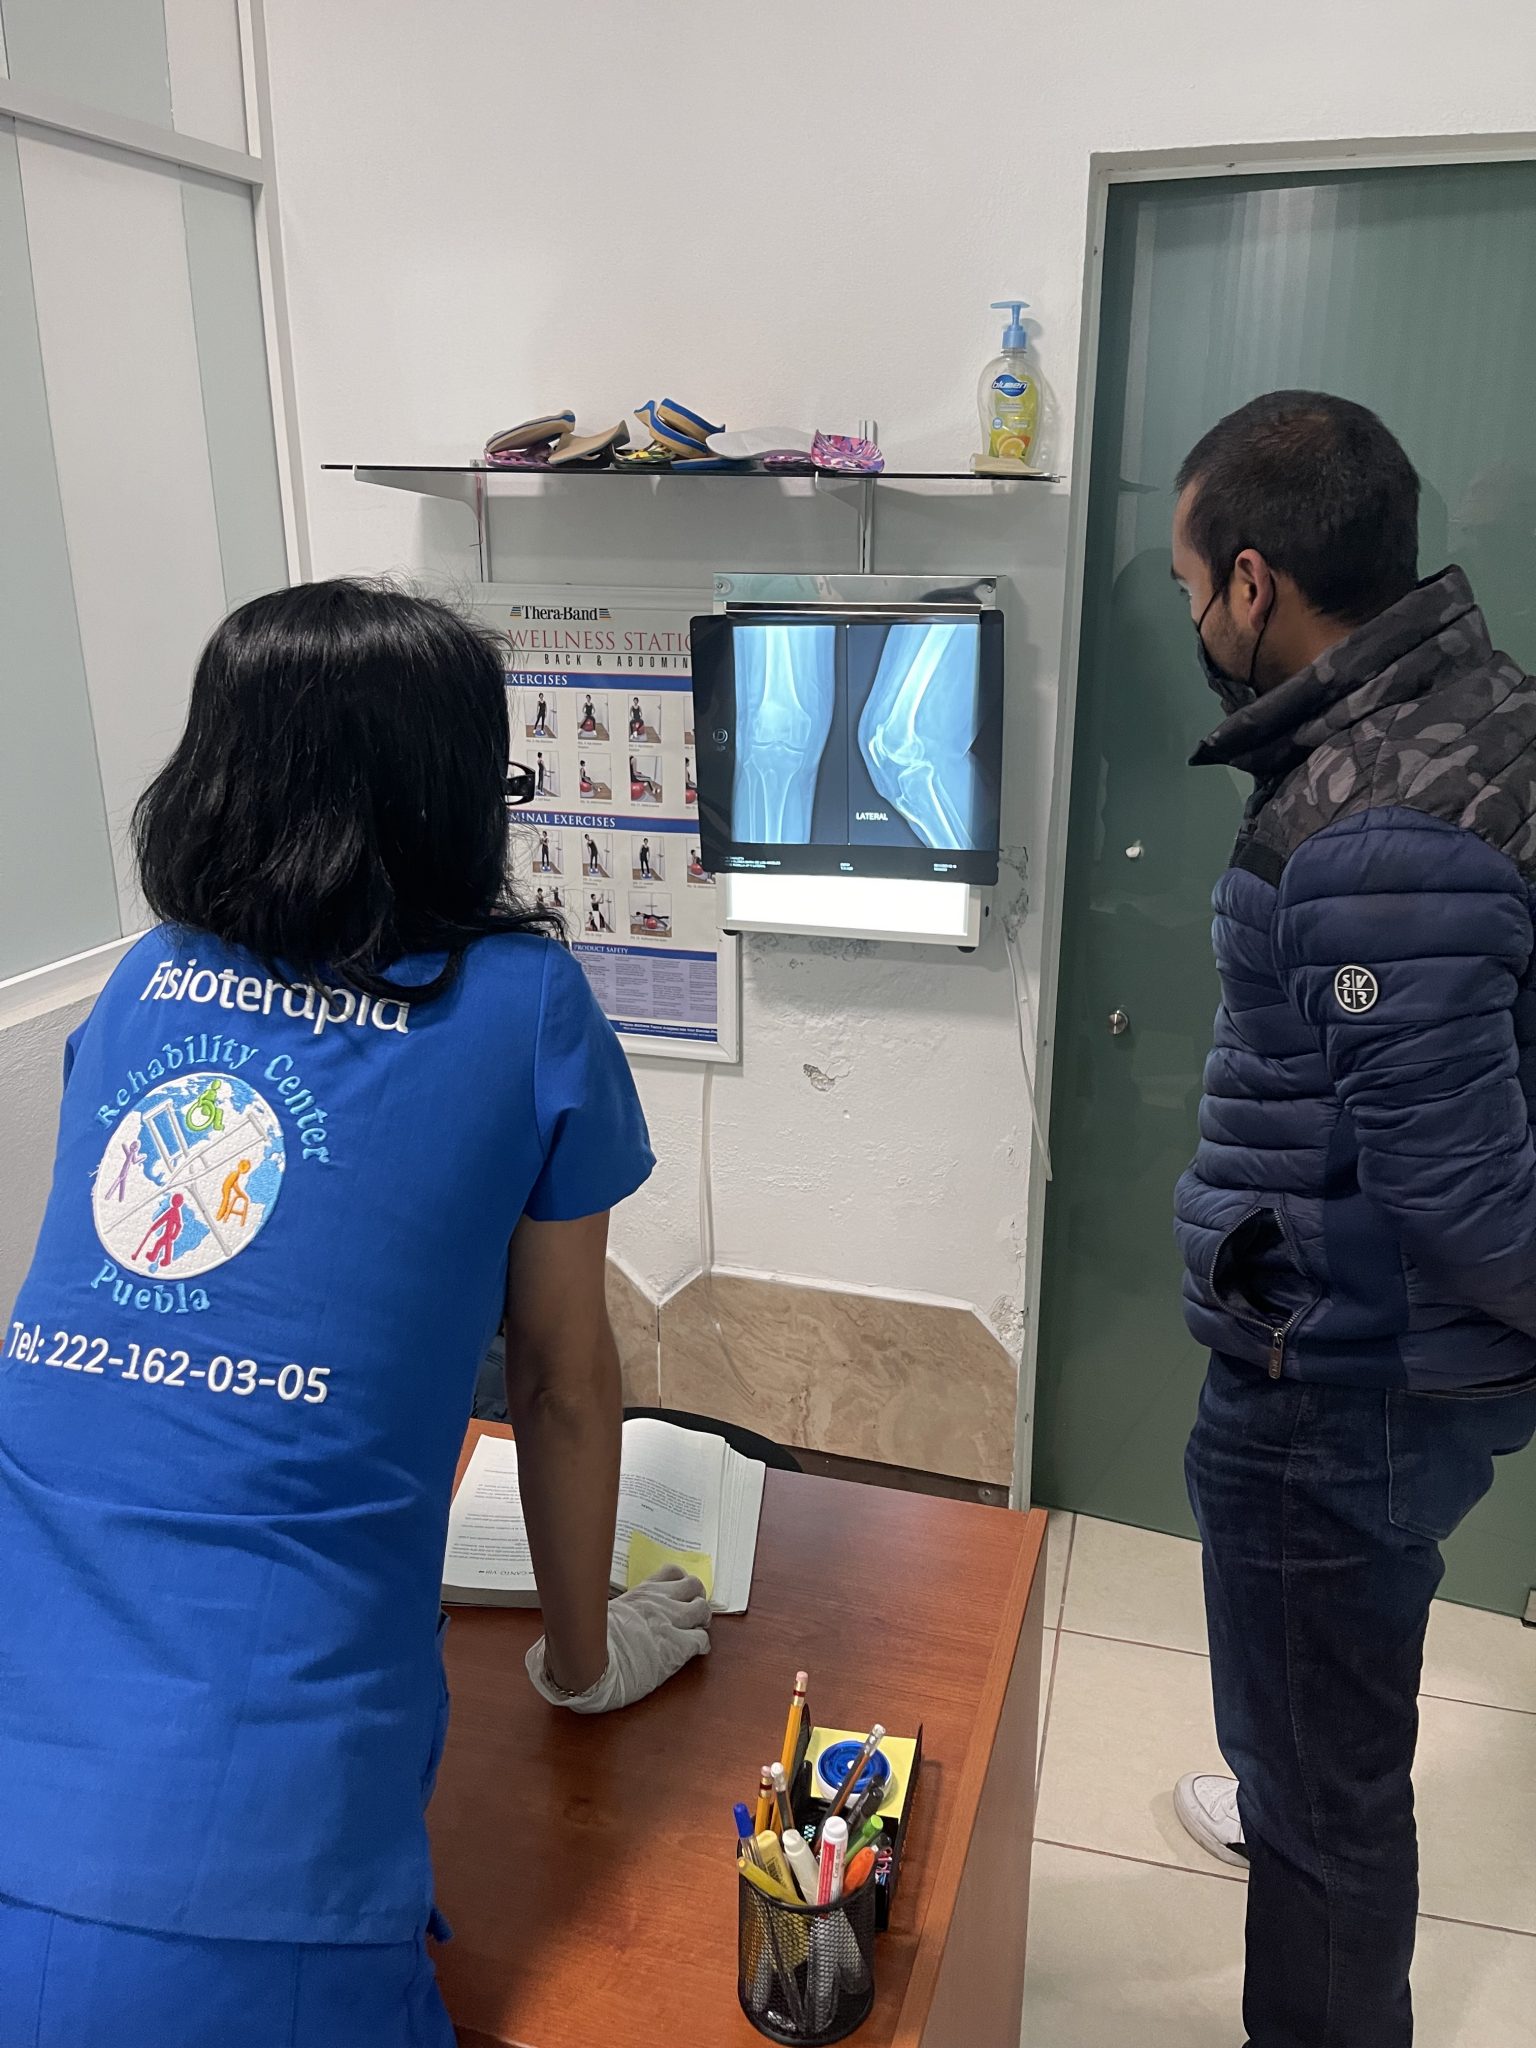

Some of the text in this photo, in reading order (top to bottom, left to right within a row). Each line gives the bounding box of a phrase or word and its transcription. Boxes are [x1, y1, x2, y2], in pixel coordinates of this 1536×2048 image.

[521, 605, 599, 621] Thera-Band
[507, 629, 615, 650] WELLNESS
[544, 653, 582, 666] BACK
[596, 654, 603, 667] &
[505, 673, 569, 686] EXERCISES
[554, 814, 617, 828] EXERCISES
[855, 811, 889, 821] LATERAL
[572, 943, 629, 955] PRODUCT SAFETY
[94, 1033, 333, 1164] Rehability Center
[90, 1259, 211, 1315] Puebla
